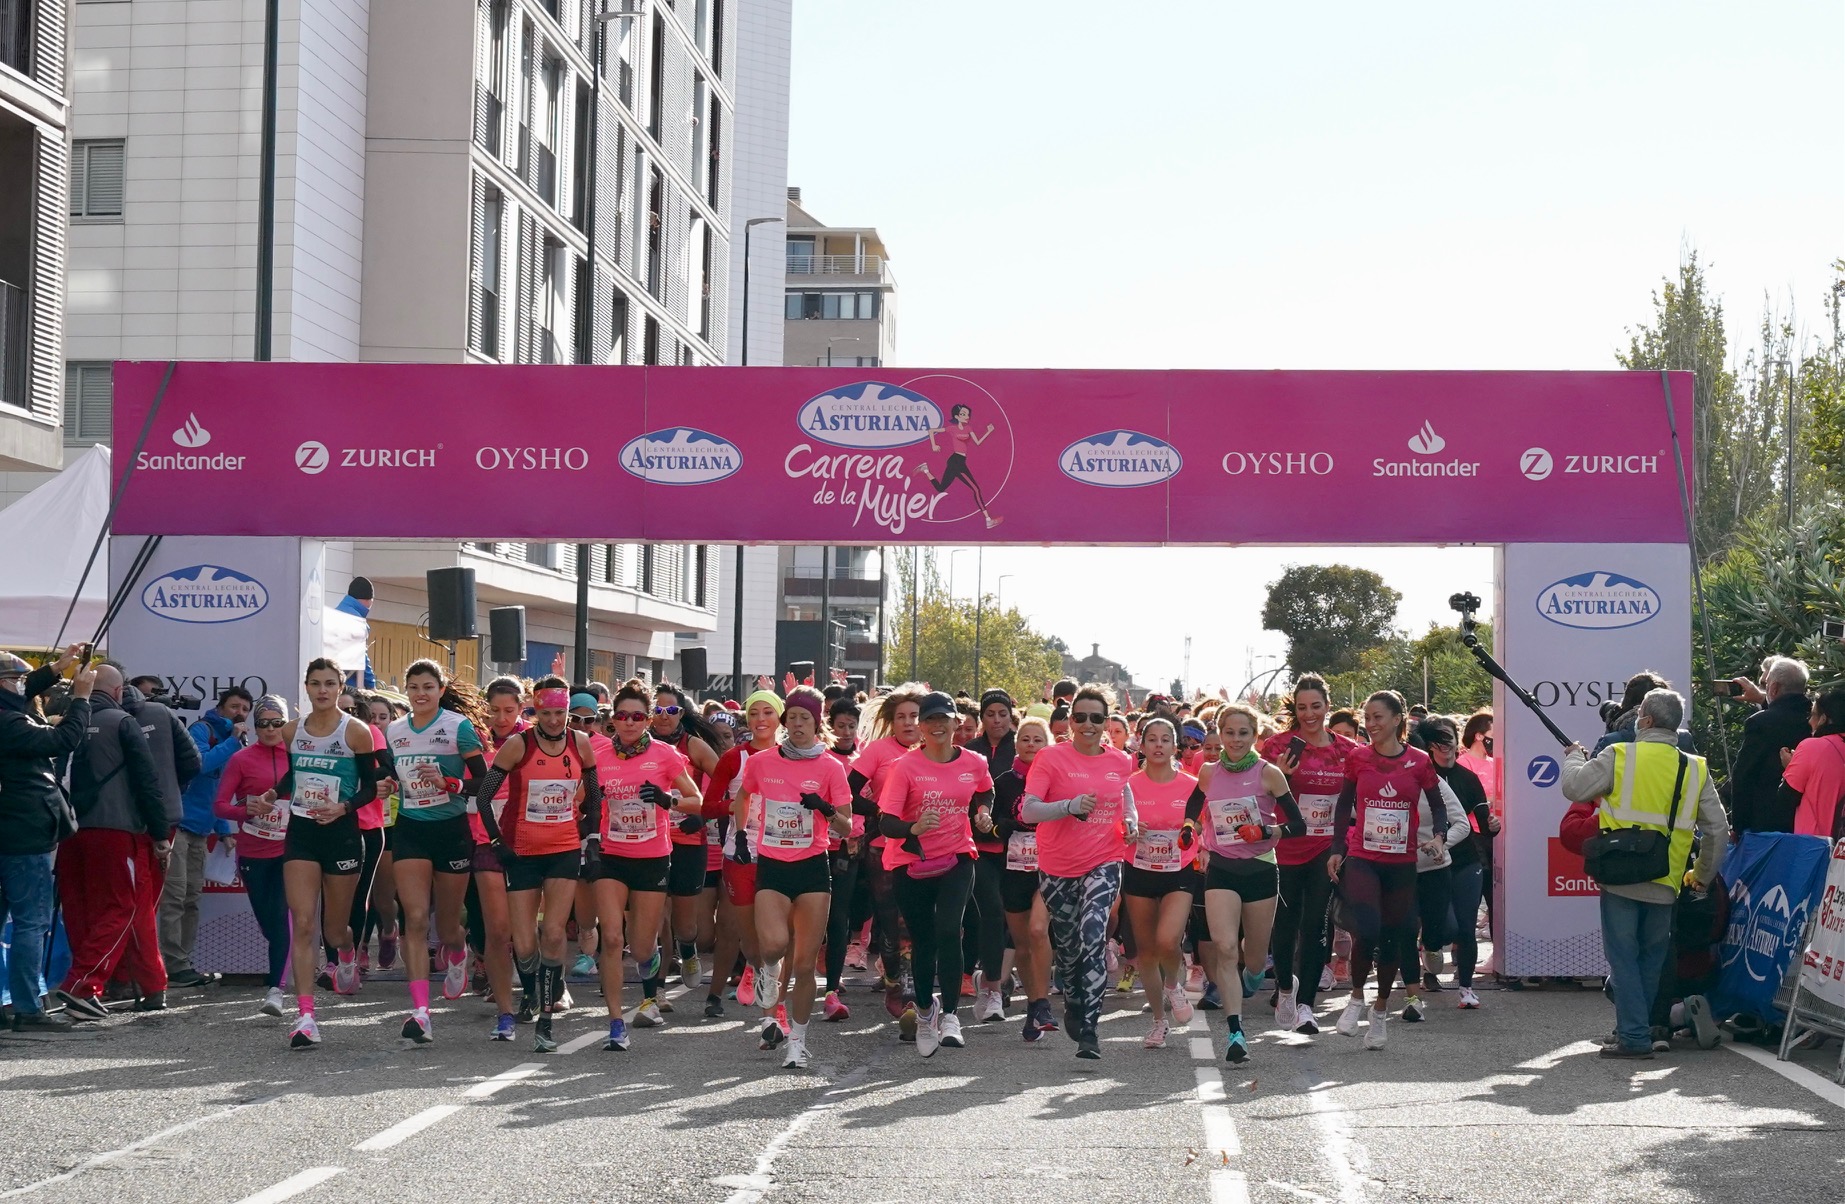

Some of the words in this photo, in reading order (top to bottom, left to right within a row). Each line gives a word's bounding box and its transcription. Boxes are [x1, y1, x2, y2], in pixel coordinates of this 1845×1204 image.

[831, 404, 877, 412] CENTRAL
[881, 404, 928, 412] LECHERA
[808, 405, 931, 432] ASTURIANA
[136, 451, 246, 471] Santander
[475, 446, 590, 472] OYSHO
[628, 446, 734, 470] ASTURIANA
[784, 443, 905, 480] Carrera
[1068, 450, 1173, 473] ASTURIANA
[1221, 451, 1335, 476] OYSHO
[1372, 457, 1481, 478] Santander
[813, 480, 836, 505] de
[840, 480, 857, 505] la
[852, 476, 949, 535] Mujer
[151, 586, 260, 609] ASTURIANA
[1545, 592, 1652, 615] ASTURIANA
[165, 675, 268, 702] YSHO
[1532, 680, 1628, 707] OYSH
[295, 756, 338, 770] ATLEET
[604, 785, 637, 795] GANAN
[605, 778, 624, 787] HOY
[542, 795, 564, 805] 016
[921, 798, 957, 807] GANAN
[922, 790, 944, 799] HOY
[1363, 797, 1412, 809] Santander
[622, 815, 643, 824] 016
[777, 819, 798, 829] 016
[1226, 814, 1247, 825] 016
[1376, 825, 1397, 835] 016
[1554, 875, 1600, 892] Sant
